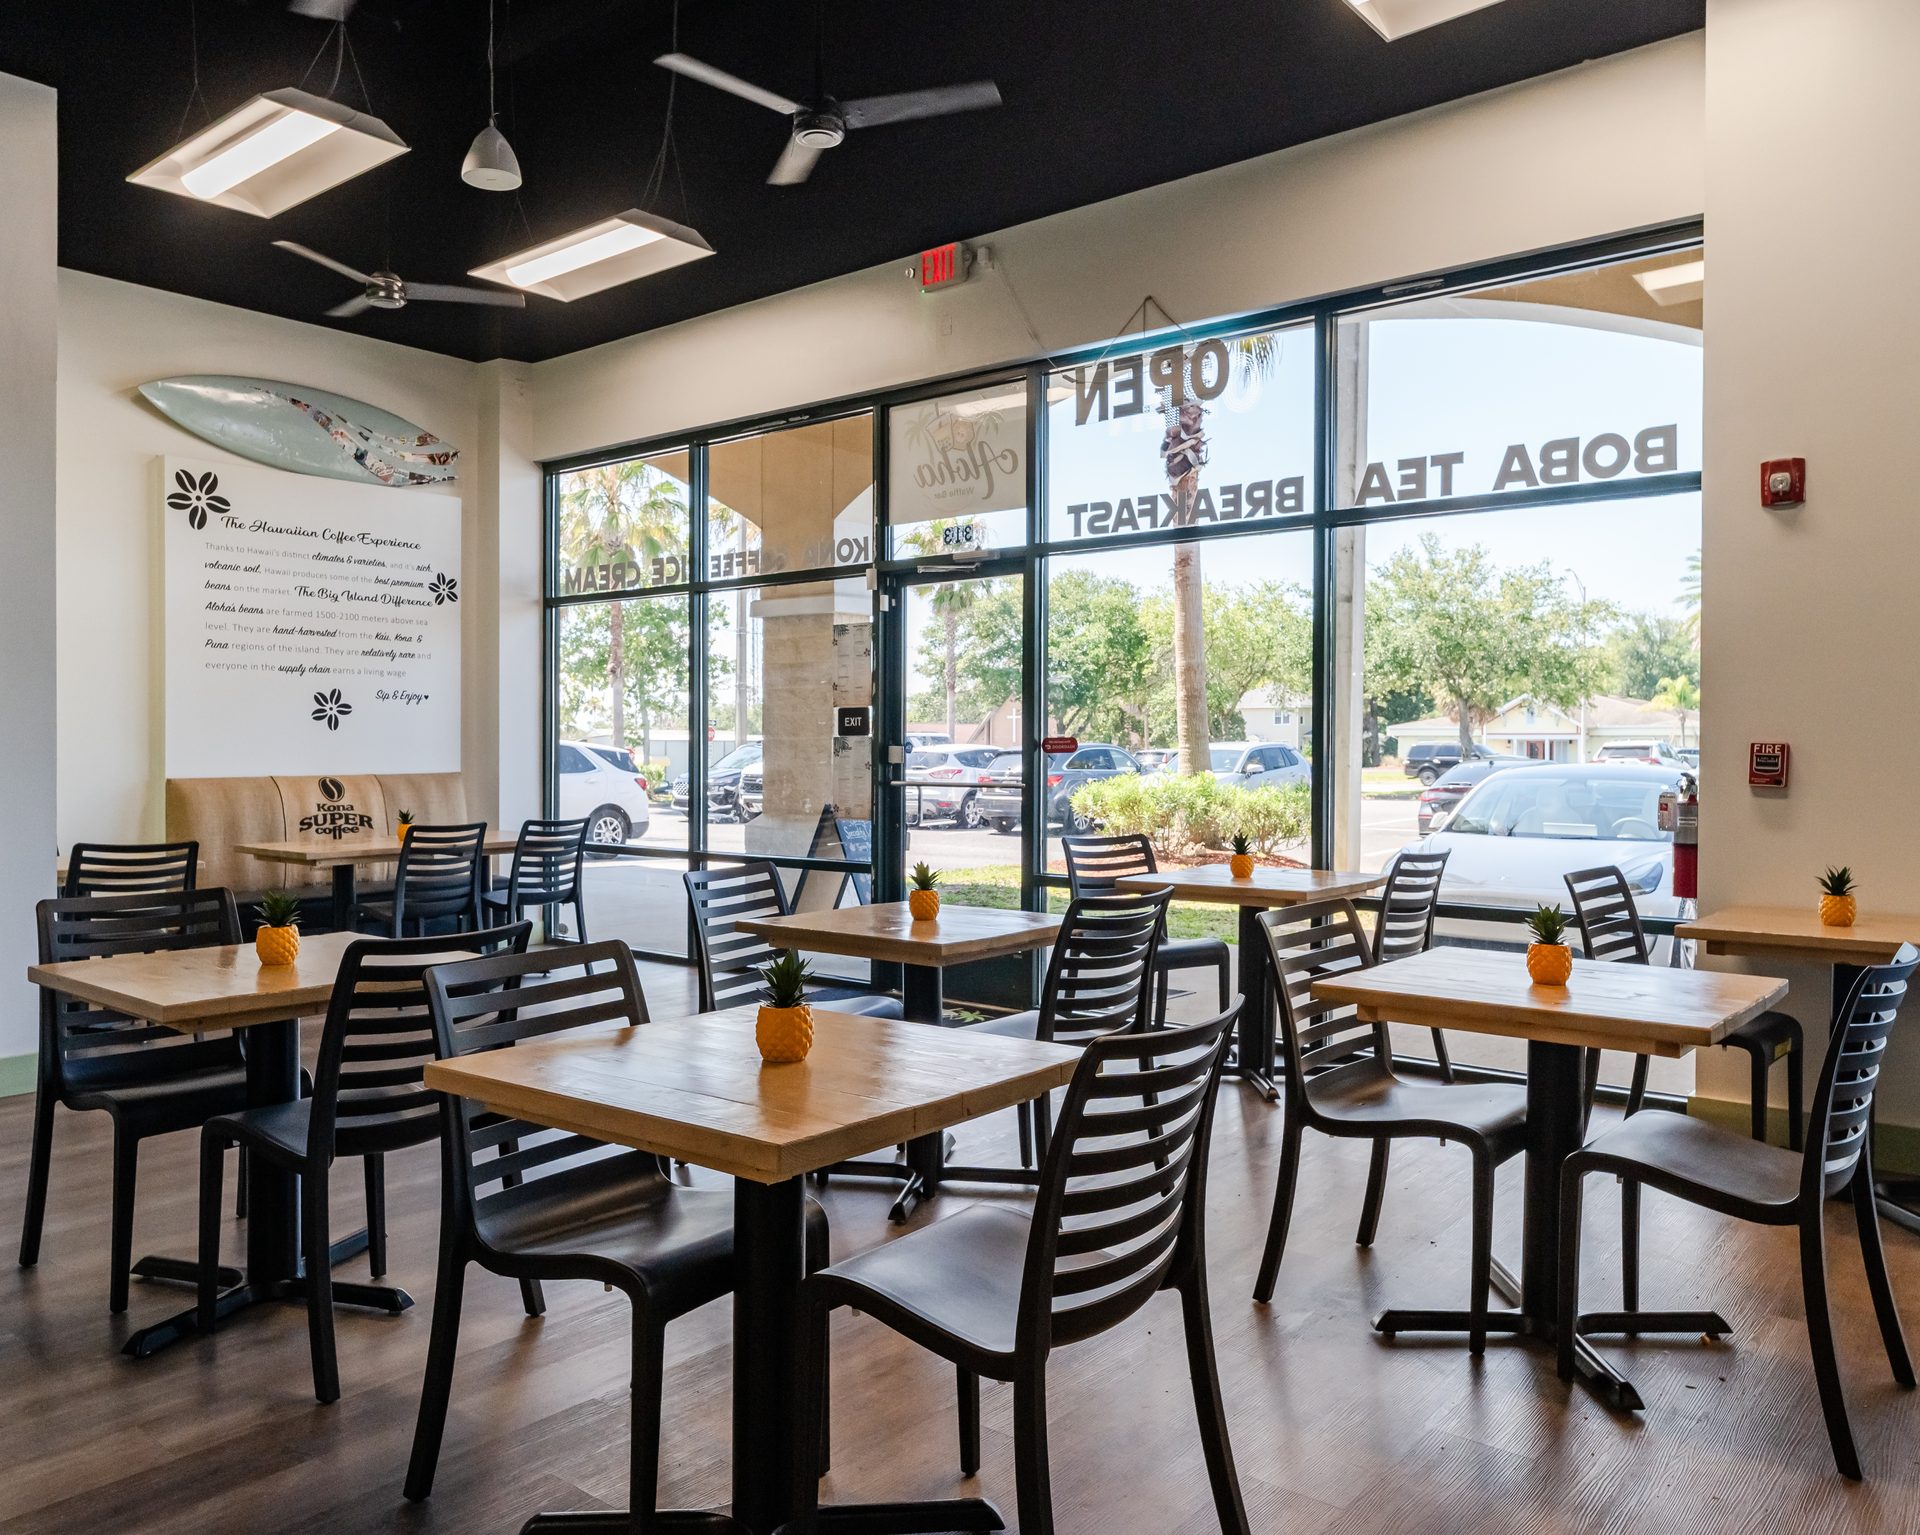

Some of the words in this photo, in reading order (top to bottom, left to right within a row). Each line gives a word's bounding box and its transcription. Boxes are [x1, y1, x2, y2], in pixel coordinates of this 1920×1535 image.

[922, 244, 955, 285] EXIT
[221, 516, 246, 530] The
[249, 520, 319, 538] Hawaiian
[322, 528, 356, 544] Coffee
[357, 532, 421, 550] Experience
[205, 542, 234, 552] Thanks
[236, 545, 245, 553] to
[247, 546, 279, 557] Hawaii's
[282, 550, 310, 560] distinct
[312, 552, 345, 563] climates
[346, 555, 353, 564] &
[353, 558, 387, 568] varieties,
[390, 562, 403, 570] and
[416, 564, 433, 573] rich,
[204, 560, 241, 571] volcanic
[264, 567, 291, 576] Hawaii
[292, 570, 328, 580] produces
[351, 575, 359, 583] of
[360, 576, 373, 584] the
[374, 576, 390, 585] best
[389, 580, 424, 588] premium
[204, 579, 231, 591] beans
[246, 585, 260, 593] the
[294, 585, 316, 598] The
[317, 588, 340, 603] Big
[341, 590, 378, 603] Island
[380, 593, 433, 607] Difference
[205, 601, 236, 613] Aloha's
[238, 603, 264, 615] beans
[266, 608, 280, 616] are
[282, 608, 313, 618] farmed
[316, 610, 360, 621] 1500-2100
[390, 617, 414, 625] above
[232, 624, 254, 634] They
[272, 625, 338, 637] hand-harvested
[338, 631, 358, 639] from
[360, 632, 373, 640] the
[394, 633, 413, 643] Kona
[416, 634, 423, 643] &
[205, 638, 229, 649] Puna
[231, 642, 265, 652] regions
[266, 643, 276, 652] of
[278, 644, 293, 653] the
[325, 646, 345, 656] They
[361, 648, 397, 662] relatively
[398, 651, 416, 659] rare
[205, 662, 248, 671] everyone
[250, 662, 259, 671] in
[261, 663, 276, 672] the
[277, 664, 306, 677] supply
[308, 664, 331, 674] chain
[332, 667, 355, 675] earns
[363, 667, 384, 678] living
[375, 689, 390, 702] Sip
[391, 690, 399, 700] &
[400, 690, 423, 706] Enjoy
[844, 717, 862, 727] EXIT
[1753, 744, 1782, 754] FIRE
[316, 803, 354, 812] Kona
[299, 812, 374, 832] SUPER
[315, 824, 359, 840] coffee
